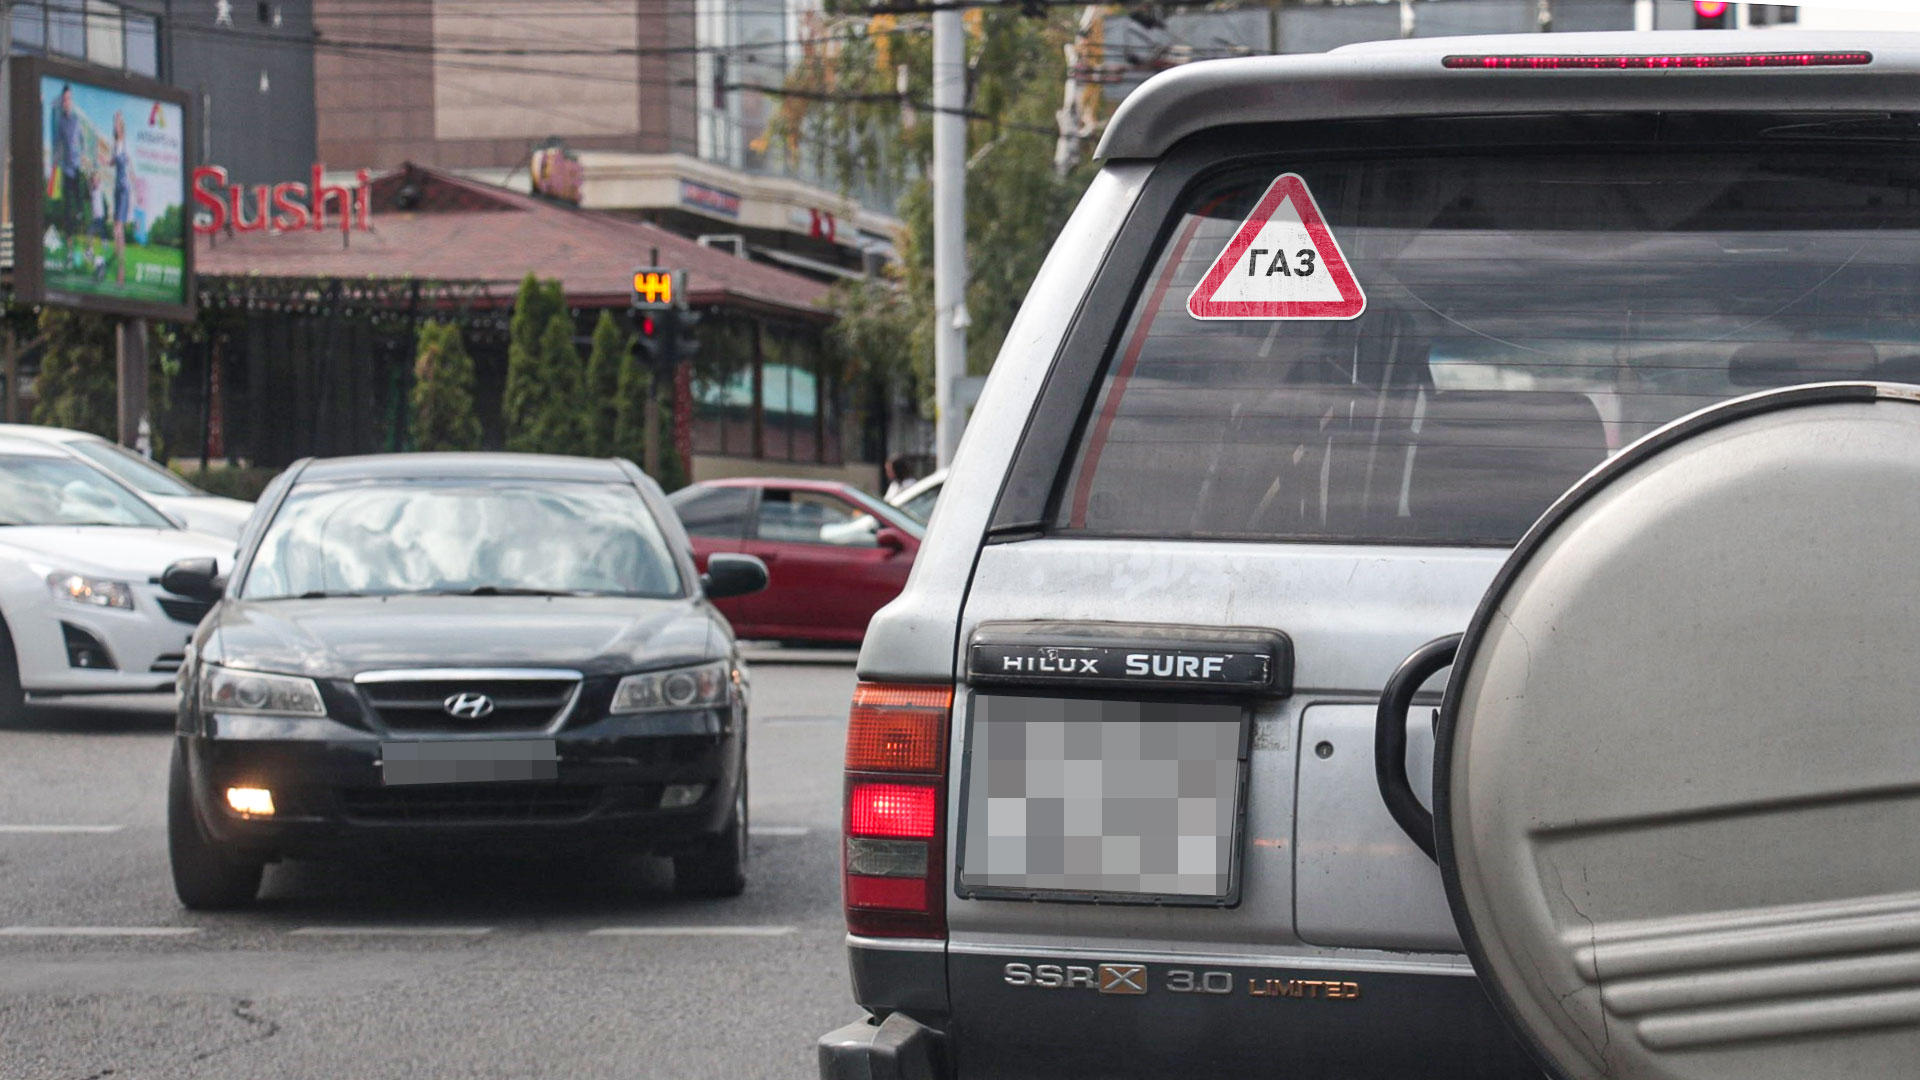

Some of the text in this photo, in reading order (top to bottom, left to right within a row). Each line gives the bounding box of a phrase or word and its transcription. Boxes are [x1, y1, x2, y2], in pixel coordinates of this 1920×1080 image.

[192, 164, 371, 234] Sushi
[1248, 249, 1316, 277] ГАЗ
[633, 272, 671, 304] 44
[1003, 653, 1225, 679] HILUX SURF
[1166, 969, 1233, 993] 3.0
[1249, 978, 1360, 999] LIMITED
